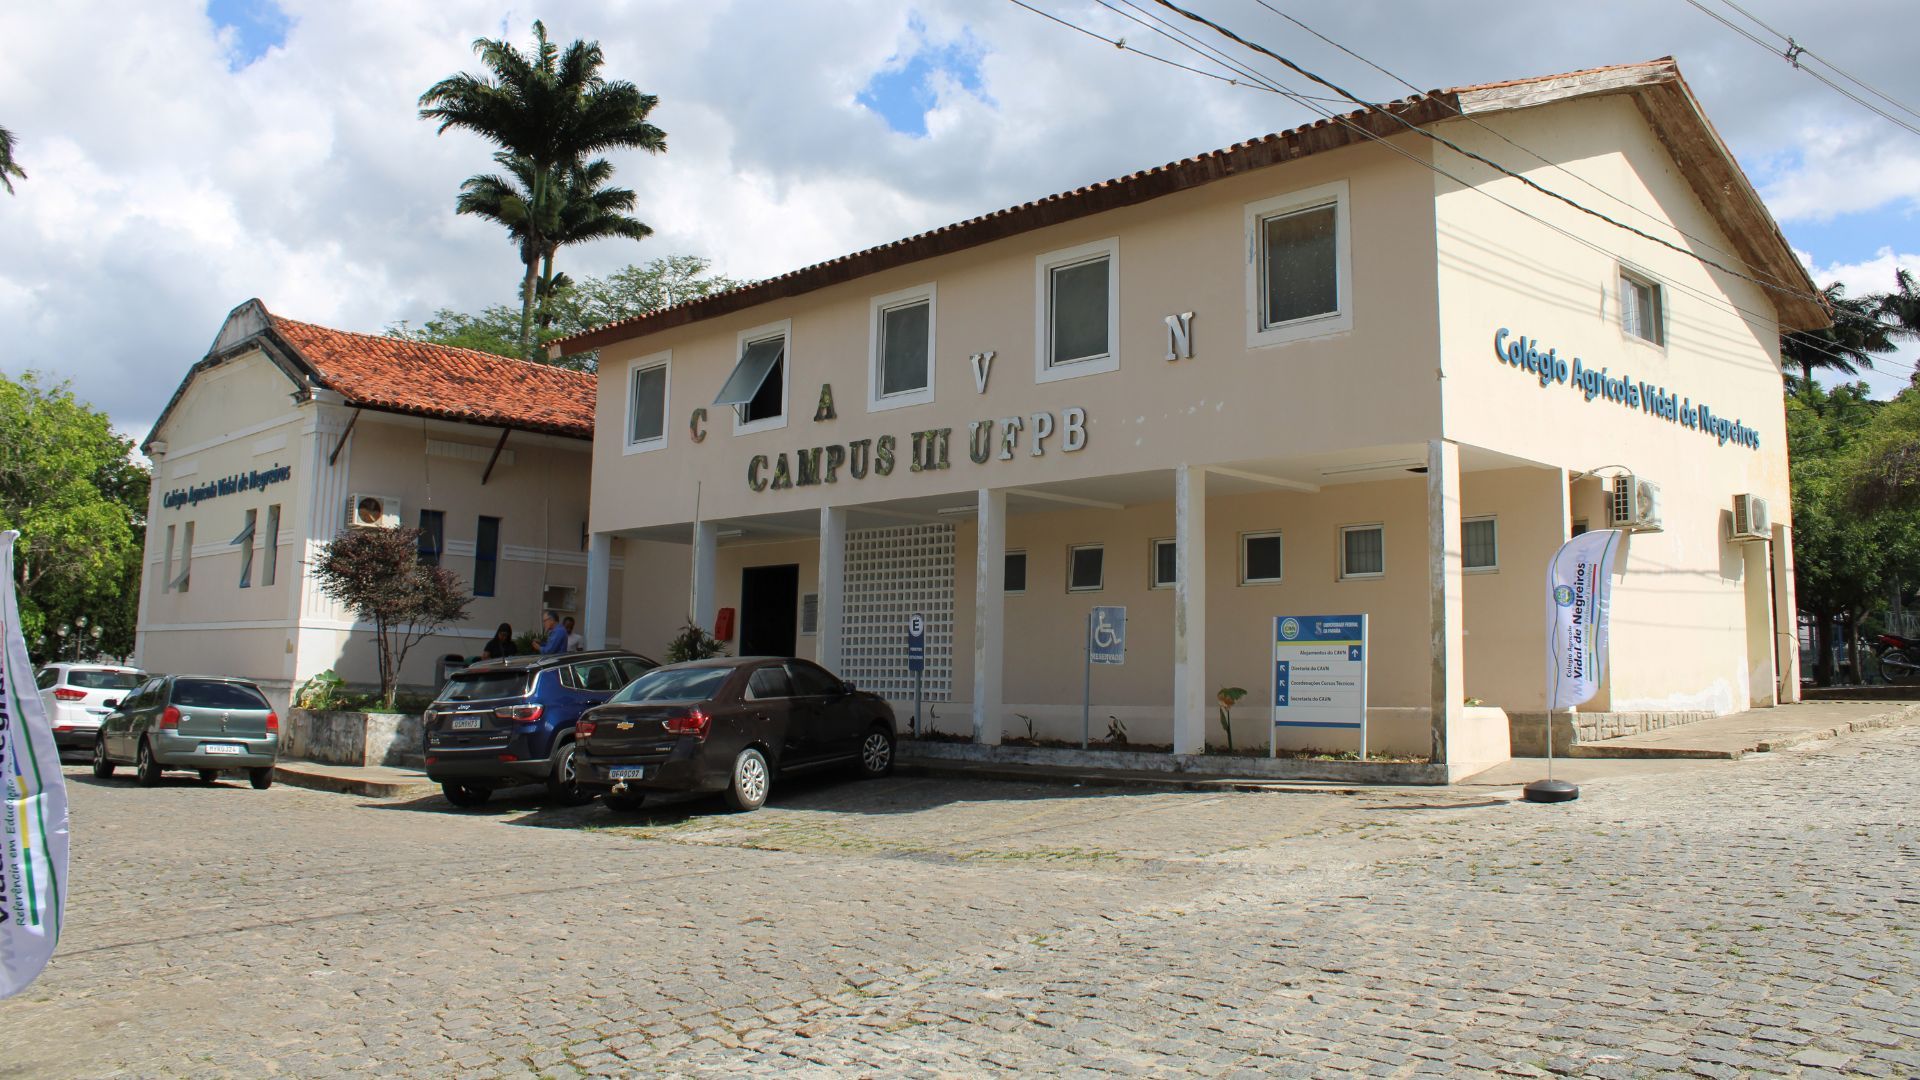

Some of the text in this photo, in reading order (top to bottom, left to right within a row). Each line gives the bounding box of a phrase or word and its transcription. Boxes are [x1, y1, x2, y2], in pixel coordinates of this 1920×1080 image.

[1494, 327, 1760, 451] Colégio Agrícola Vidal de Negreiros
[163, 463, 291, 510] Colégio Agrícola Vidal de Negreiros
[747, 407, 1088, 493] CAMPUS III UFPB
[1572, 562, 1586, 679] Vidal de Negreiros
[8, 840, 18, 858] em
[10, 863, 26, 926] Referência
